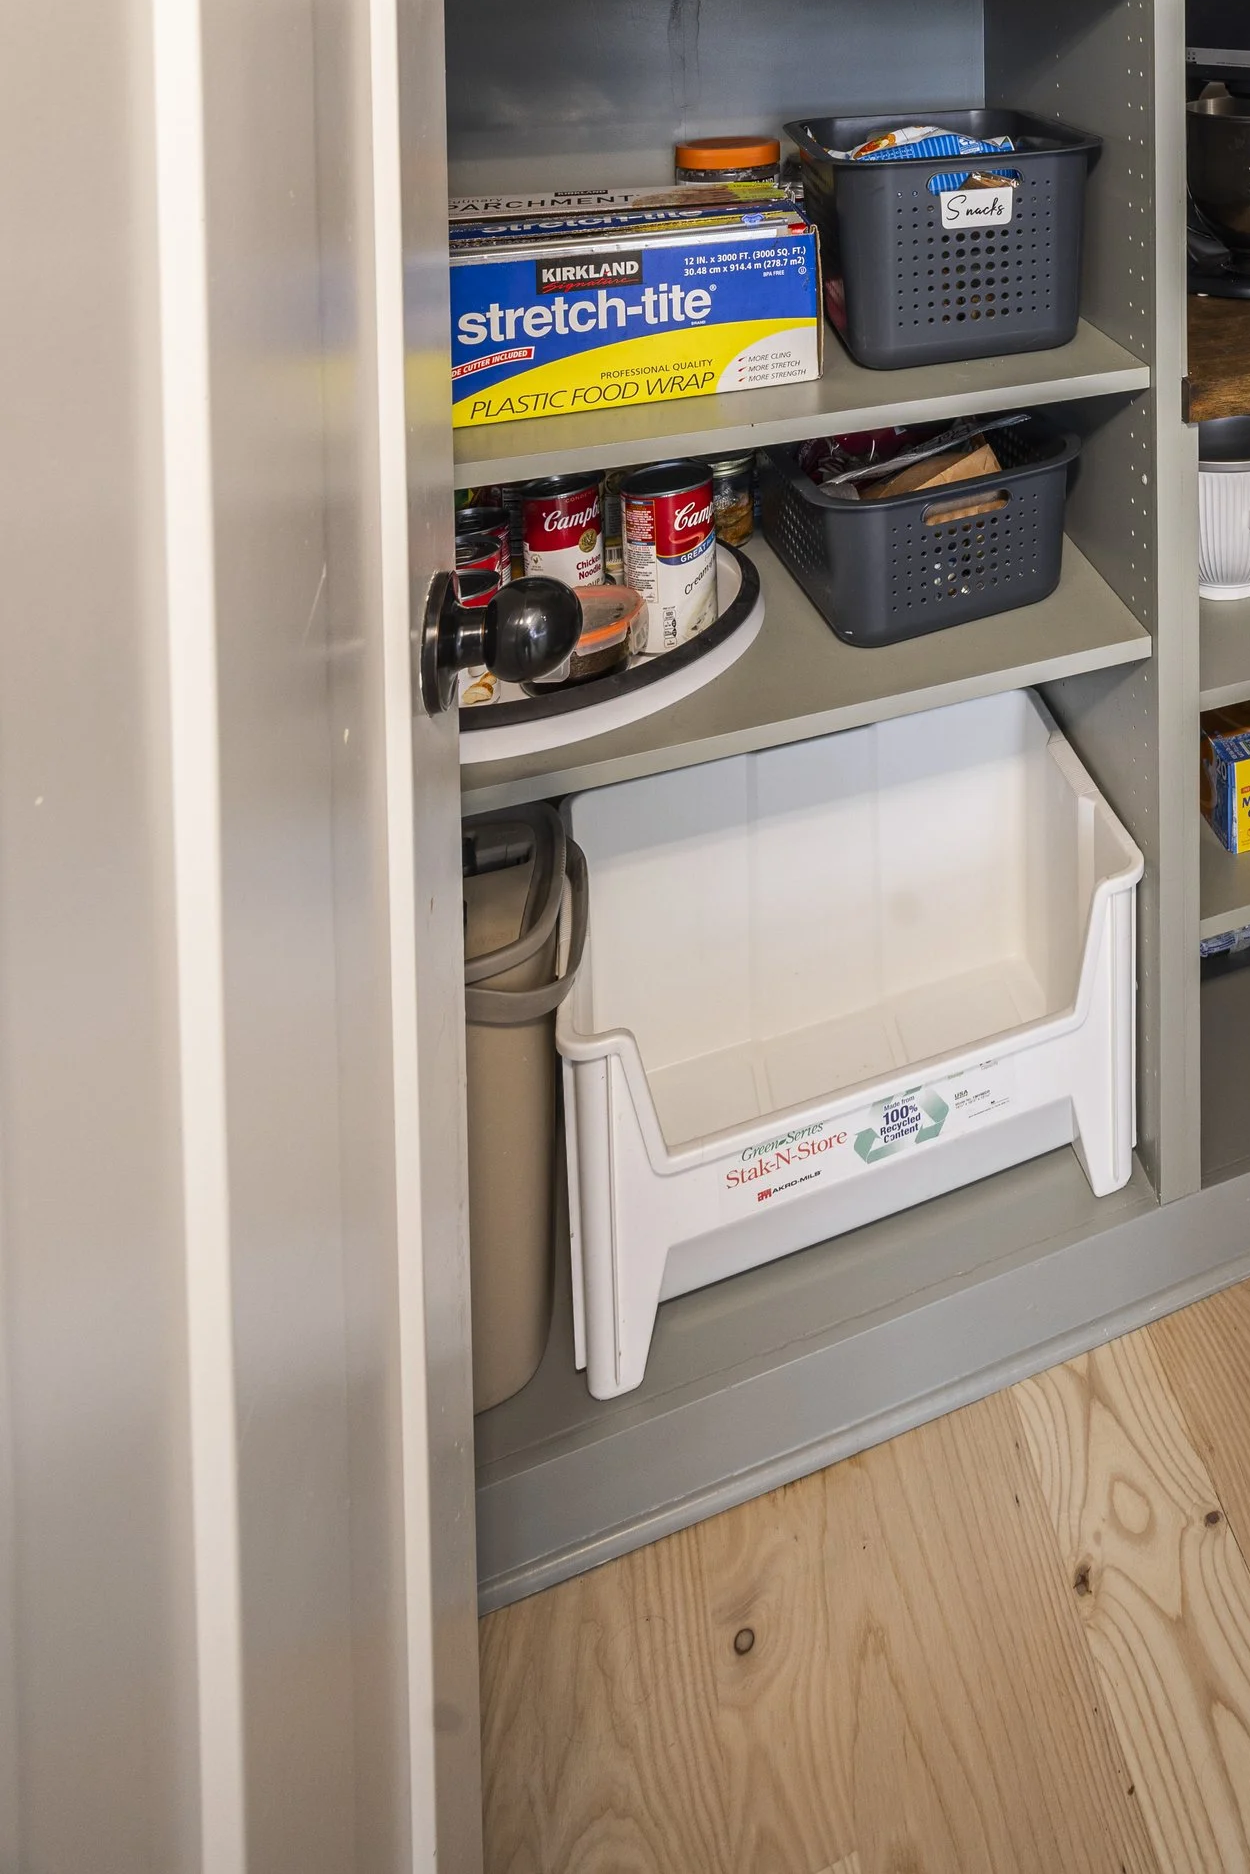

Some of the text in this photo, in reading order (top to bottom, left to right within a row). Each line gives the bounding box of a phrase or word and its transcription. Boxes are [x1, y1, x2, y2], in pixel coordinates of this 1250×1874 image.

[946, 194, 1005, 222] Snacks
[684, 257, 694, 266] 12
[696, 256, 708, 264] IN.
[717, 253, 737, 263] 3000
[739, 251, 751, 260] FT.
[752, 248, 775, 259] (3000
[777, 247, 790, 256] SQ.
[792, 246, 807, 255] FT.)
[684, 266, 707, 276] 30.48
[730, 263, 752, 272] 914.4
[763, 259, 788, 269] (278.7
[790, 256, 806, 266] m2)
[542, 260, 639, 283] KIRKLAND
[542, 277, 640, 294] Signature
[457, 283, 712, 345] stretch-tite
[463, 349, 528, 374] CUTTER INCLUDED
[748, 351, 792, 363] MORE CLING
[748, 360, 801, 372] MORE STRETCH
[600, 359, 713, 380] PROFESSIONAL QUALITY
[748, 369, 807, 382] MORE STRENGTH
[470, 371, 715, 420] PLASTIC FOOD WRAP
[576, 554, 600, 570] Chicken
[681, 546, 708, 563] GREAT
[578, 564, 601, 580] Noodle
[1216, 757, 1227, 781] 20
[884, 1095, 915, 1111] Made from
[954, 1089, 968, 1098] USA
[880, 1112, 921, 1137] Recycled
[882, 1103, 918, 1126] 100%
[742, 1122, 824, 1162] Green Series
[884, 1124, 919, 1144] Content
[726, 1131, 848, 1189] Stak-N-Store
